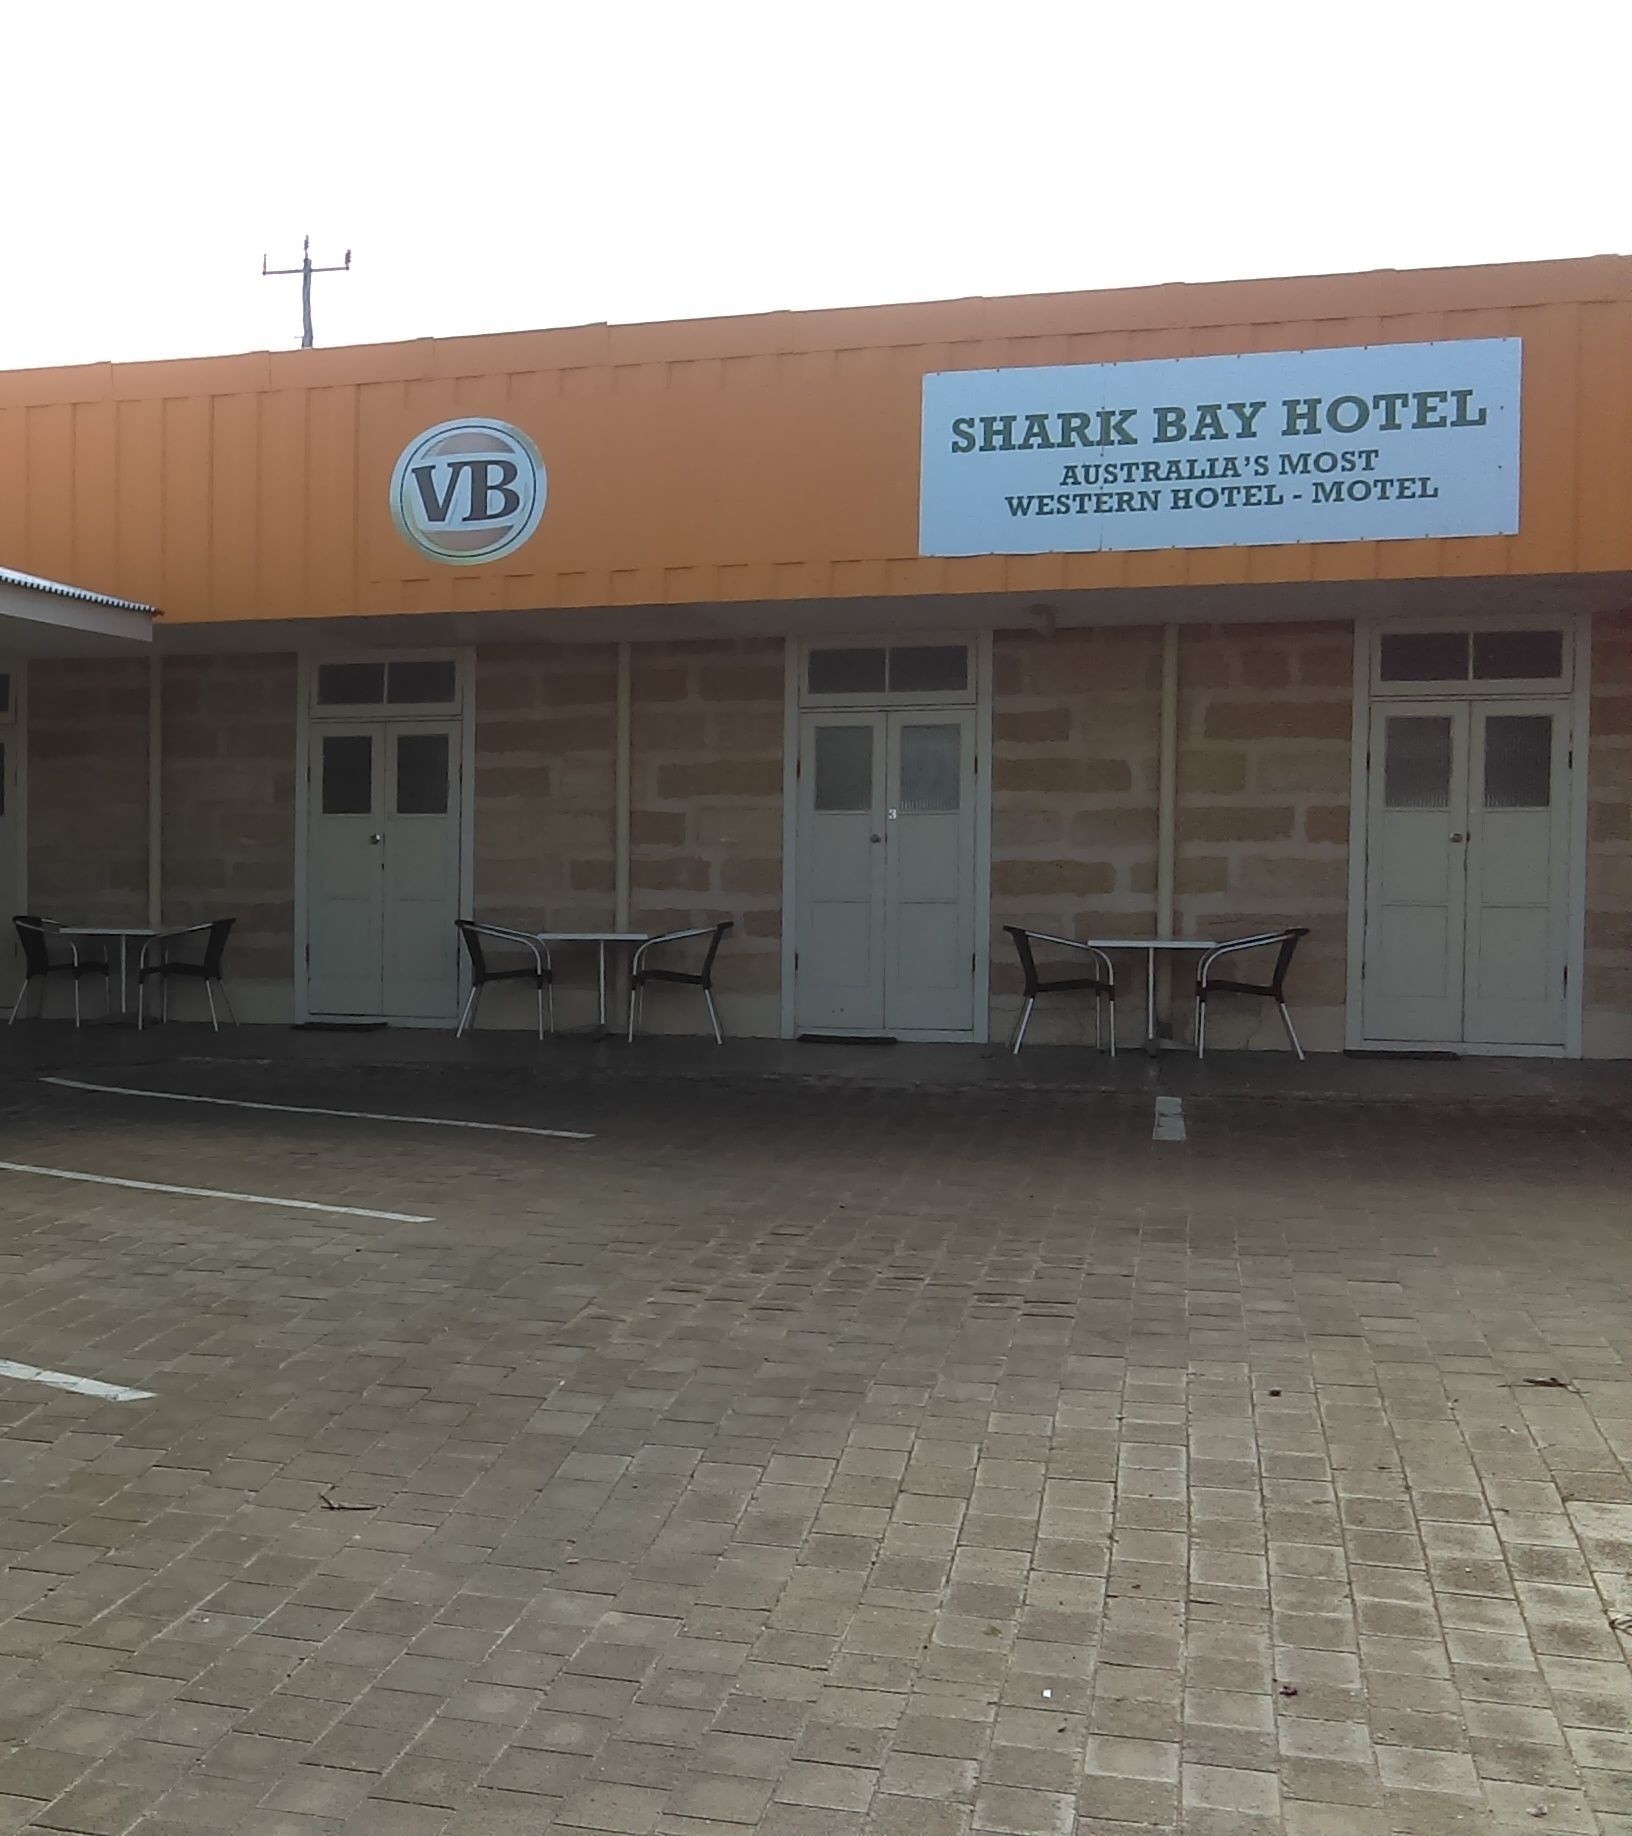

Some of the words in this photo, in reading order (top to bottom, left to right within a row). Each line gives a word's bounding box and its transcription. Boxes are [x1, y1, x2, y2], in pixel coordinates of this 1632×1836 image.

[951, 408, 1138, 453] SHARK
[1153, 401, 1267, 444] BAY
[1281, 389, 1488, 437] HOTEL
[411, 459, 521, 523] VB
[1059, 455, 1269, 486] AUSTRALIA'S
[1279, 449, 1380, 475] MOST
[1005, 489, 1162, 517] WESTERN
[1170, 484, 1285, 510] HOTEL
[1312, 477, 1440, 504] MOTEL
